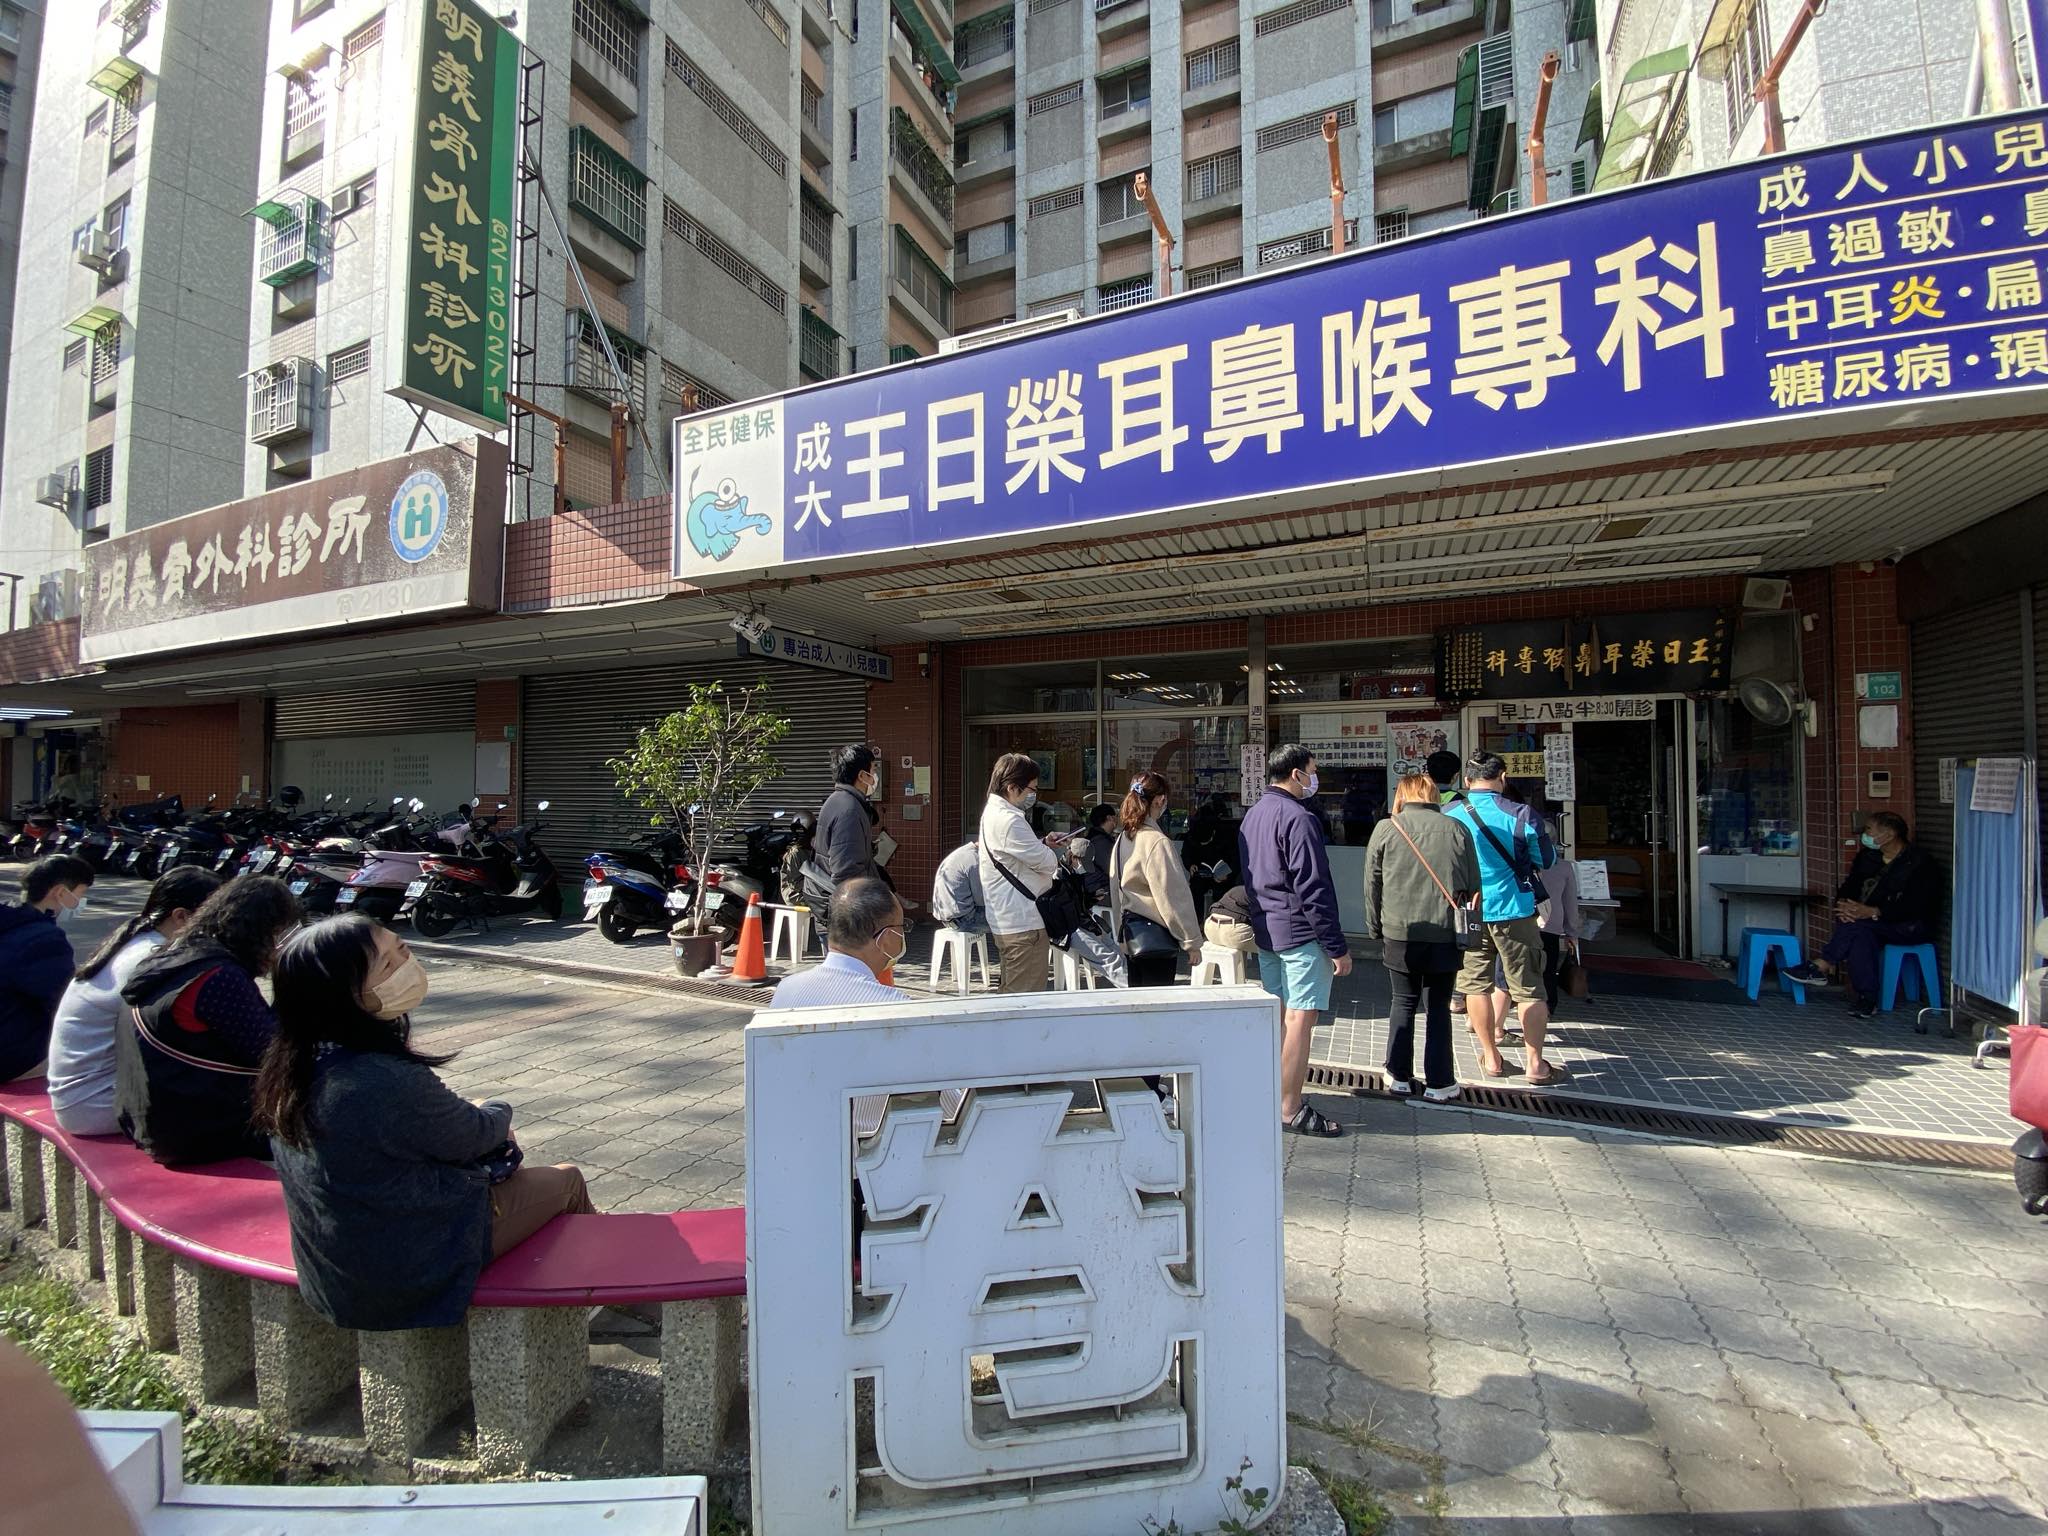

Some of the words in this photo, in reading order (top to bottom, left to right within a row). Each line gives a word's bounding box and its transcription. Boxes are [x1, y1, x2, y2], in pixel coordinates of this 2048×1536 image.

[1757, 122, 2048, 215] 成人小兒
[486, 238, 508, 404] 2130271
[841, 221, 1735, 519] 王日榮耳鼻喉專科
[684, 408, 776, 456] 全民健保
[793, 421, 833, 532] 成大
[1873, 684, 1897, 695] 102
